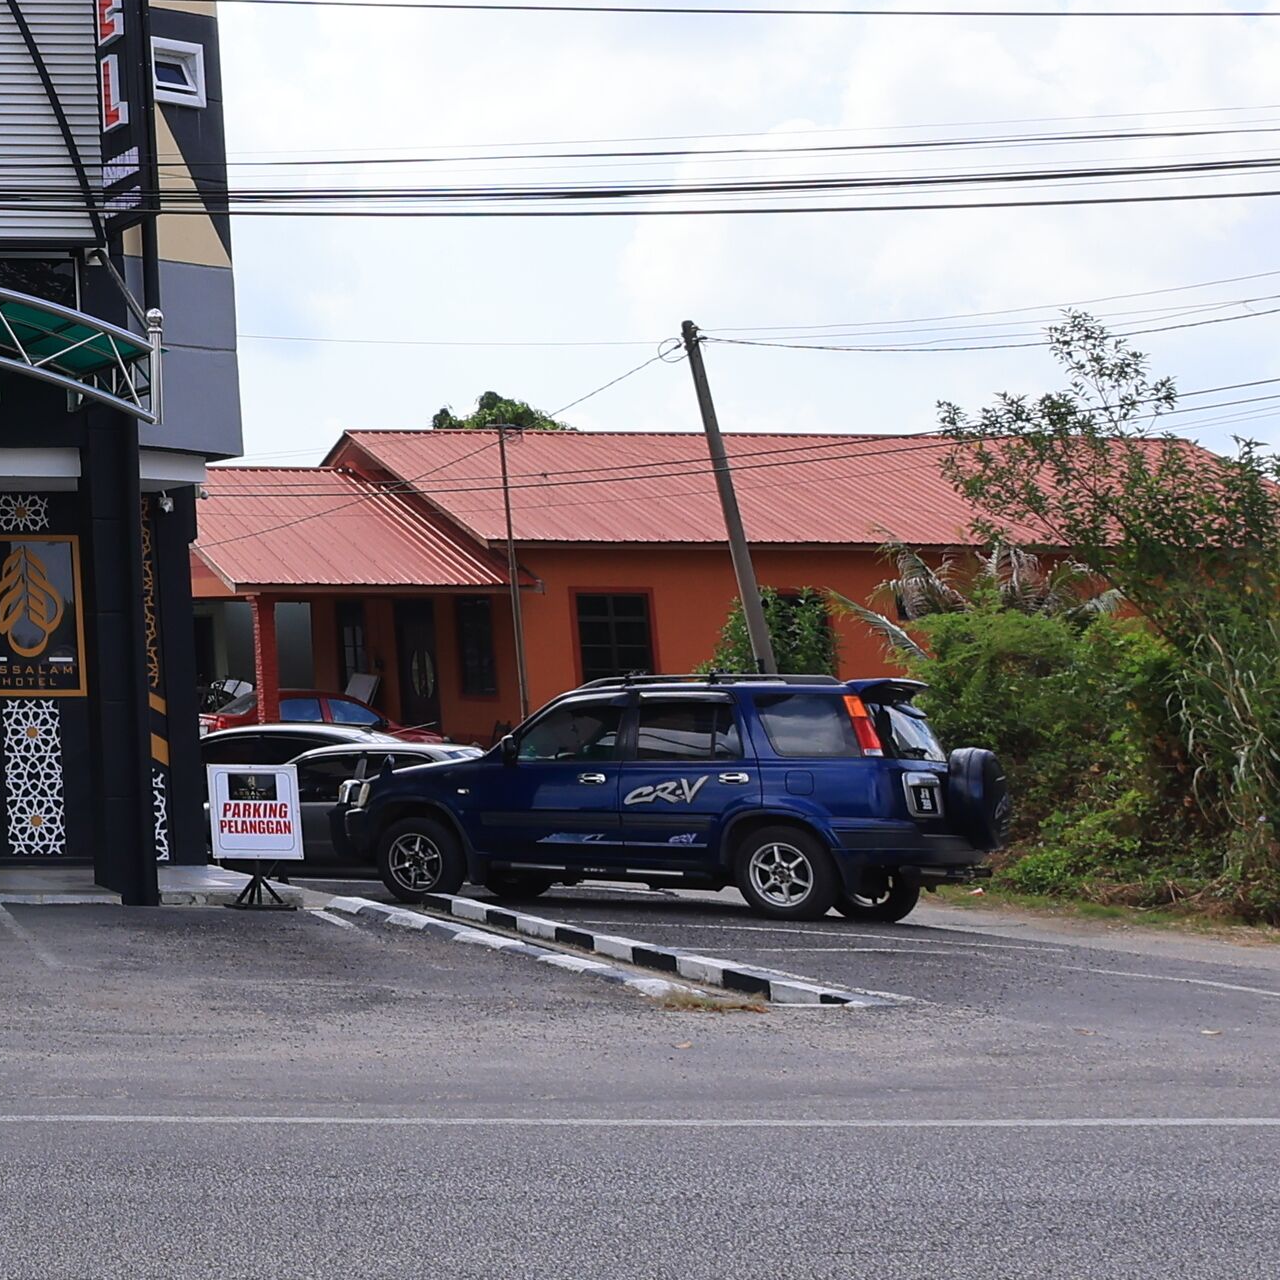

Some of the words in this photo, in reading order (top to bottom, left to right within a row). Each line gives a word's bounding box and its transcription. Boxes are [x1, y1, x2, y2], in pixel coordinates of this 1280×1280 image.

[2, 677, 57, 686] HOTEL
[223, 802, 288, 819] PARKING
[220, 820, 292, 834] PELANGGAN
